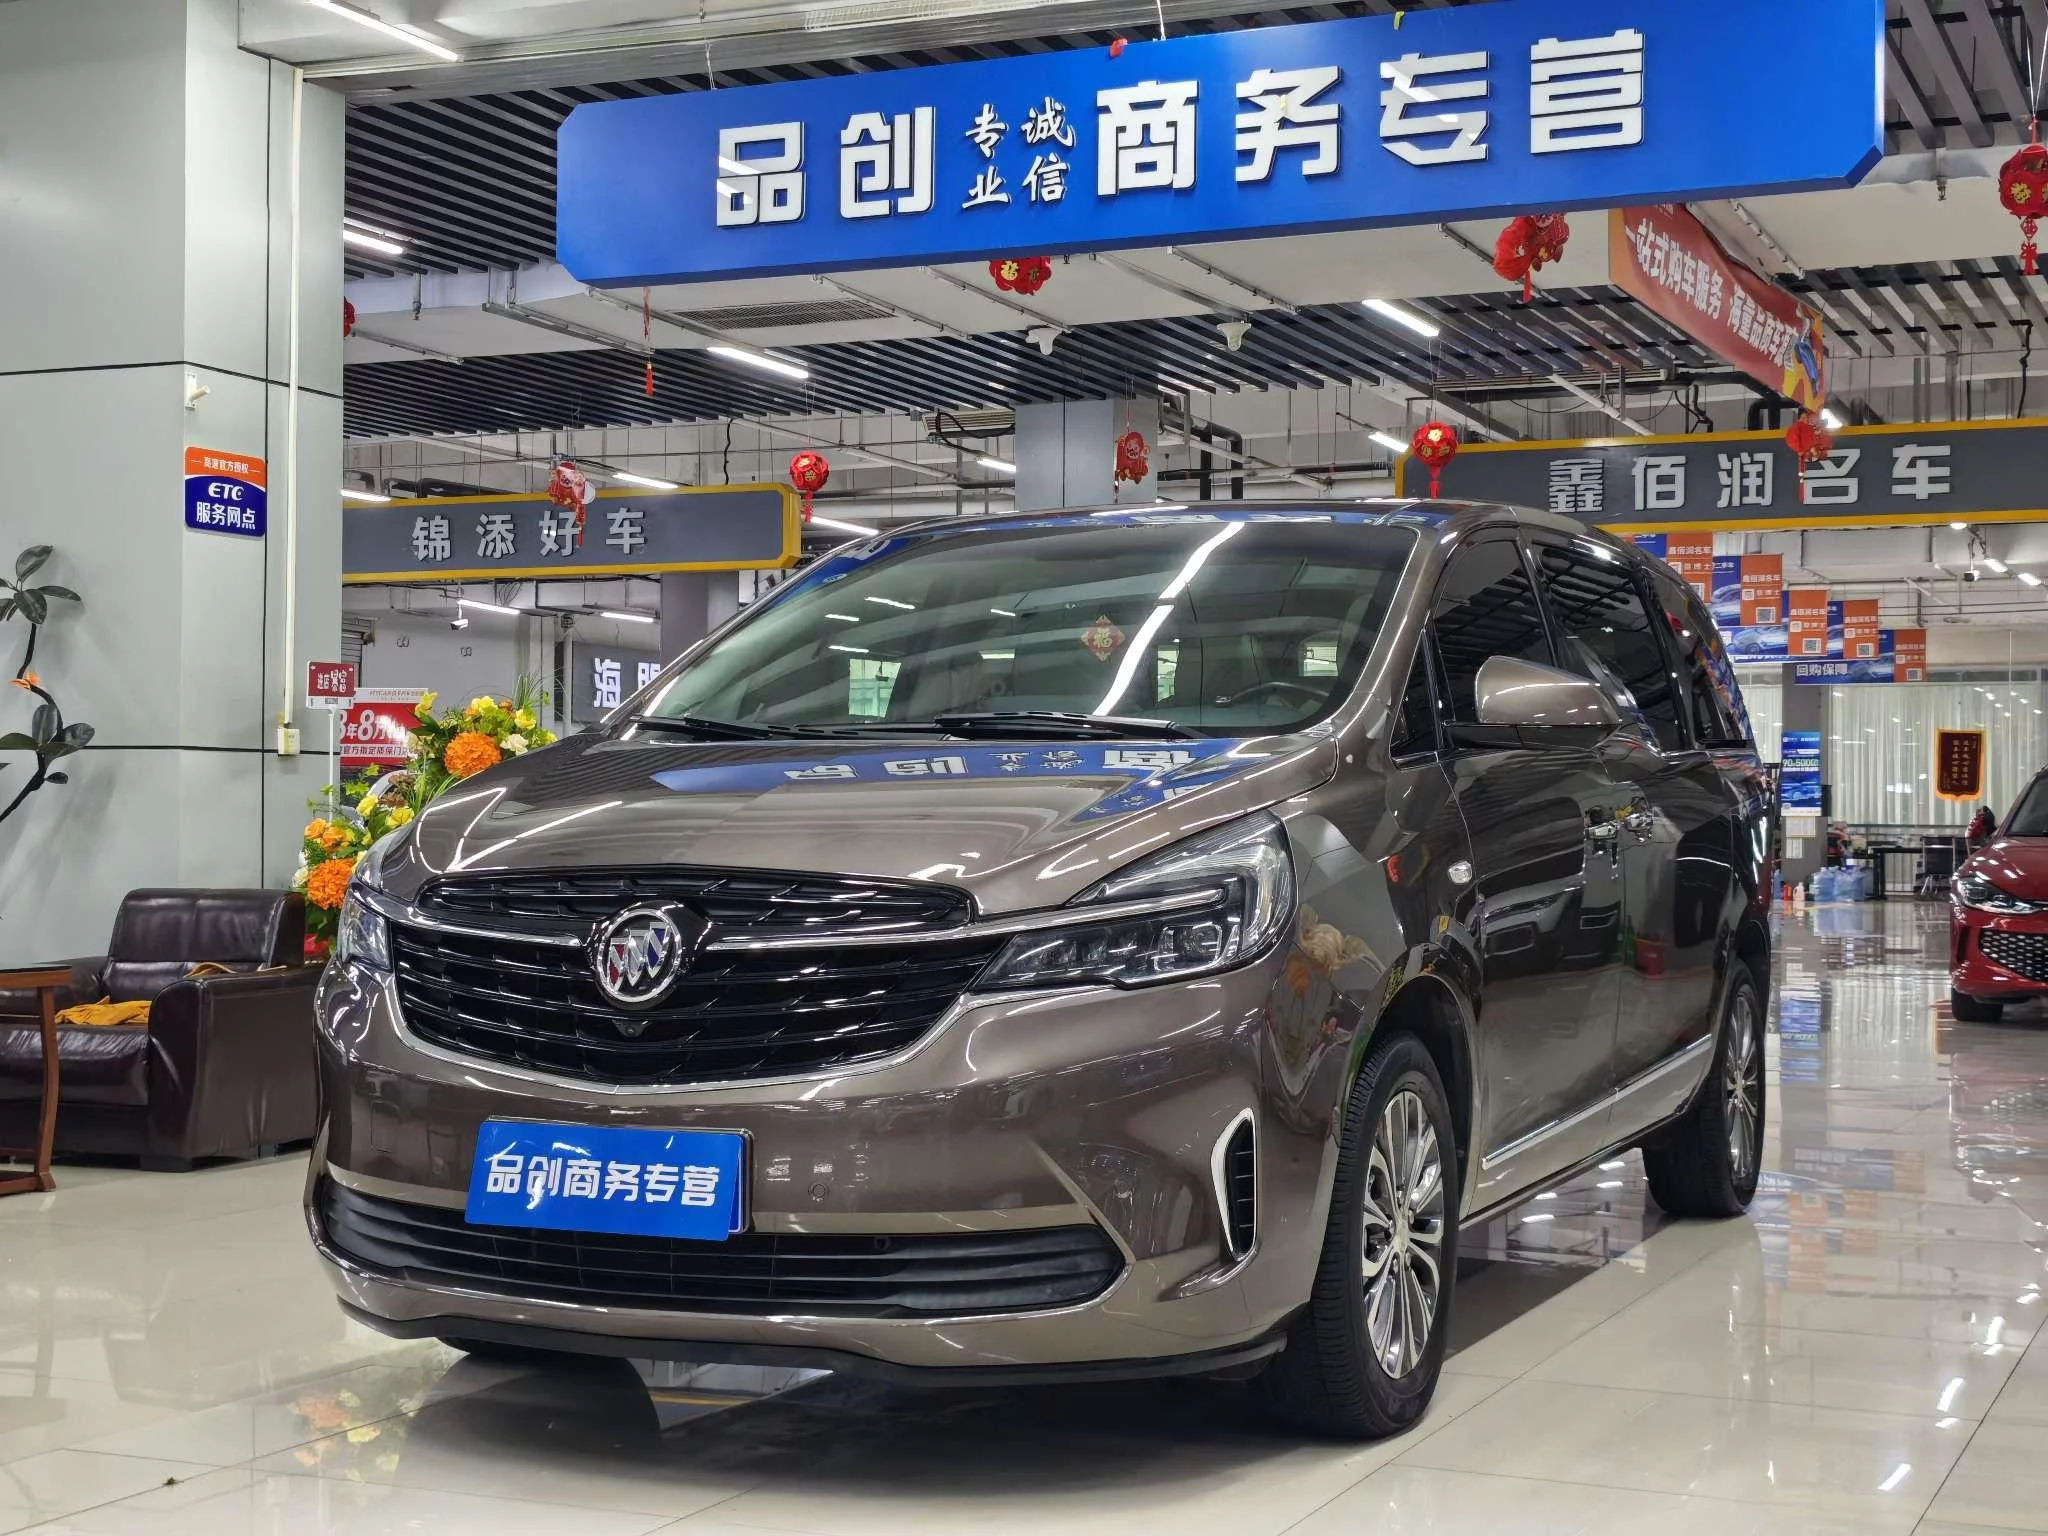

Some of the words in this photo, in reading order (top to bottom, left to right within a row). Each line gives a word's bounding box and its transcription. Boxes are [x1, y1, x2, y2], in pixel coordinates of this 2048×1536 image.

[716, 106, 936, 227] 品创
[1097, 28, 1645, 197] 商务专营
[1625, 218, 1723, 320] 一站式购车服务
[208, 482, 245, 501] ETC
[1549, 443, 1952, 514] 鑫佰润名车
[196, 501, 256, 530] 服务网点
[411, 506, 645, 562] 锦添好车
[1796, 663, 1848, 677] 回购保障
[486, 1154, 721, 1207] 品创商务专营
